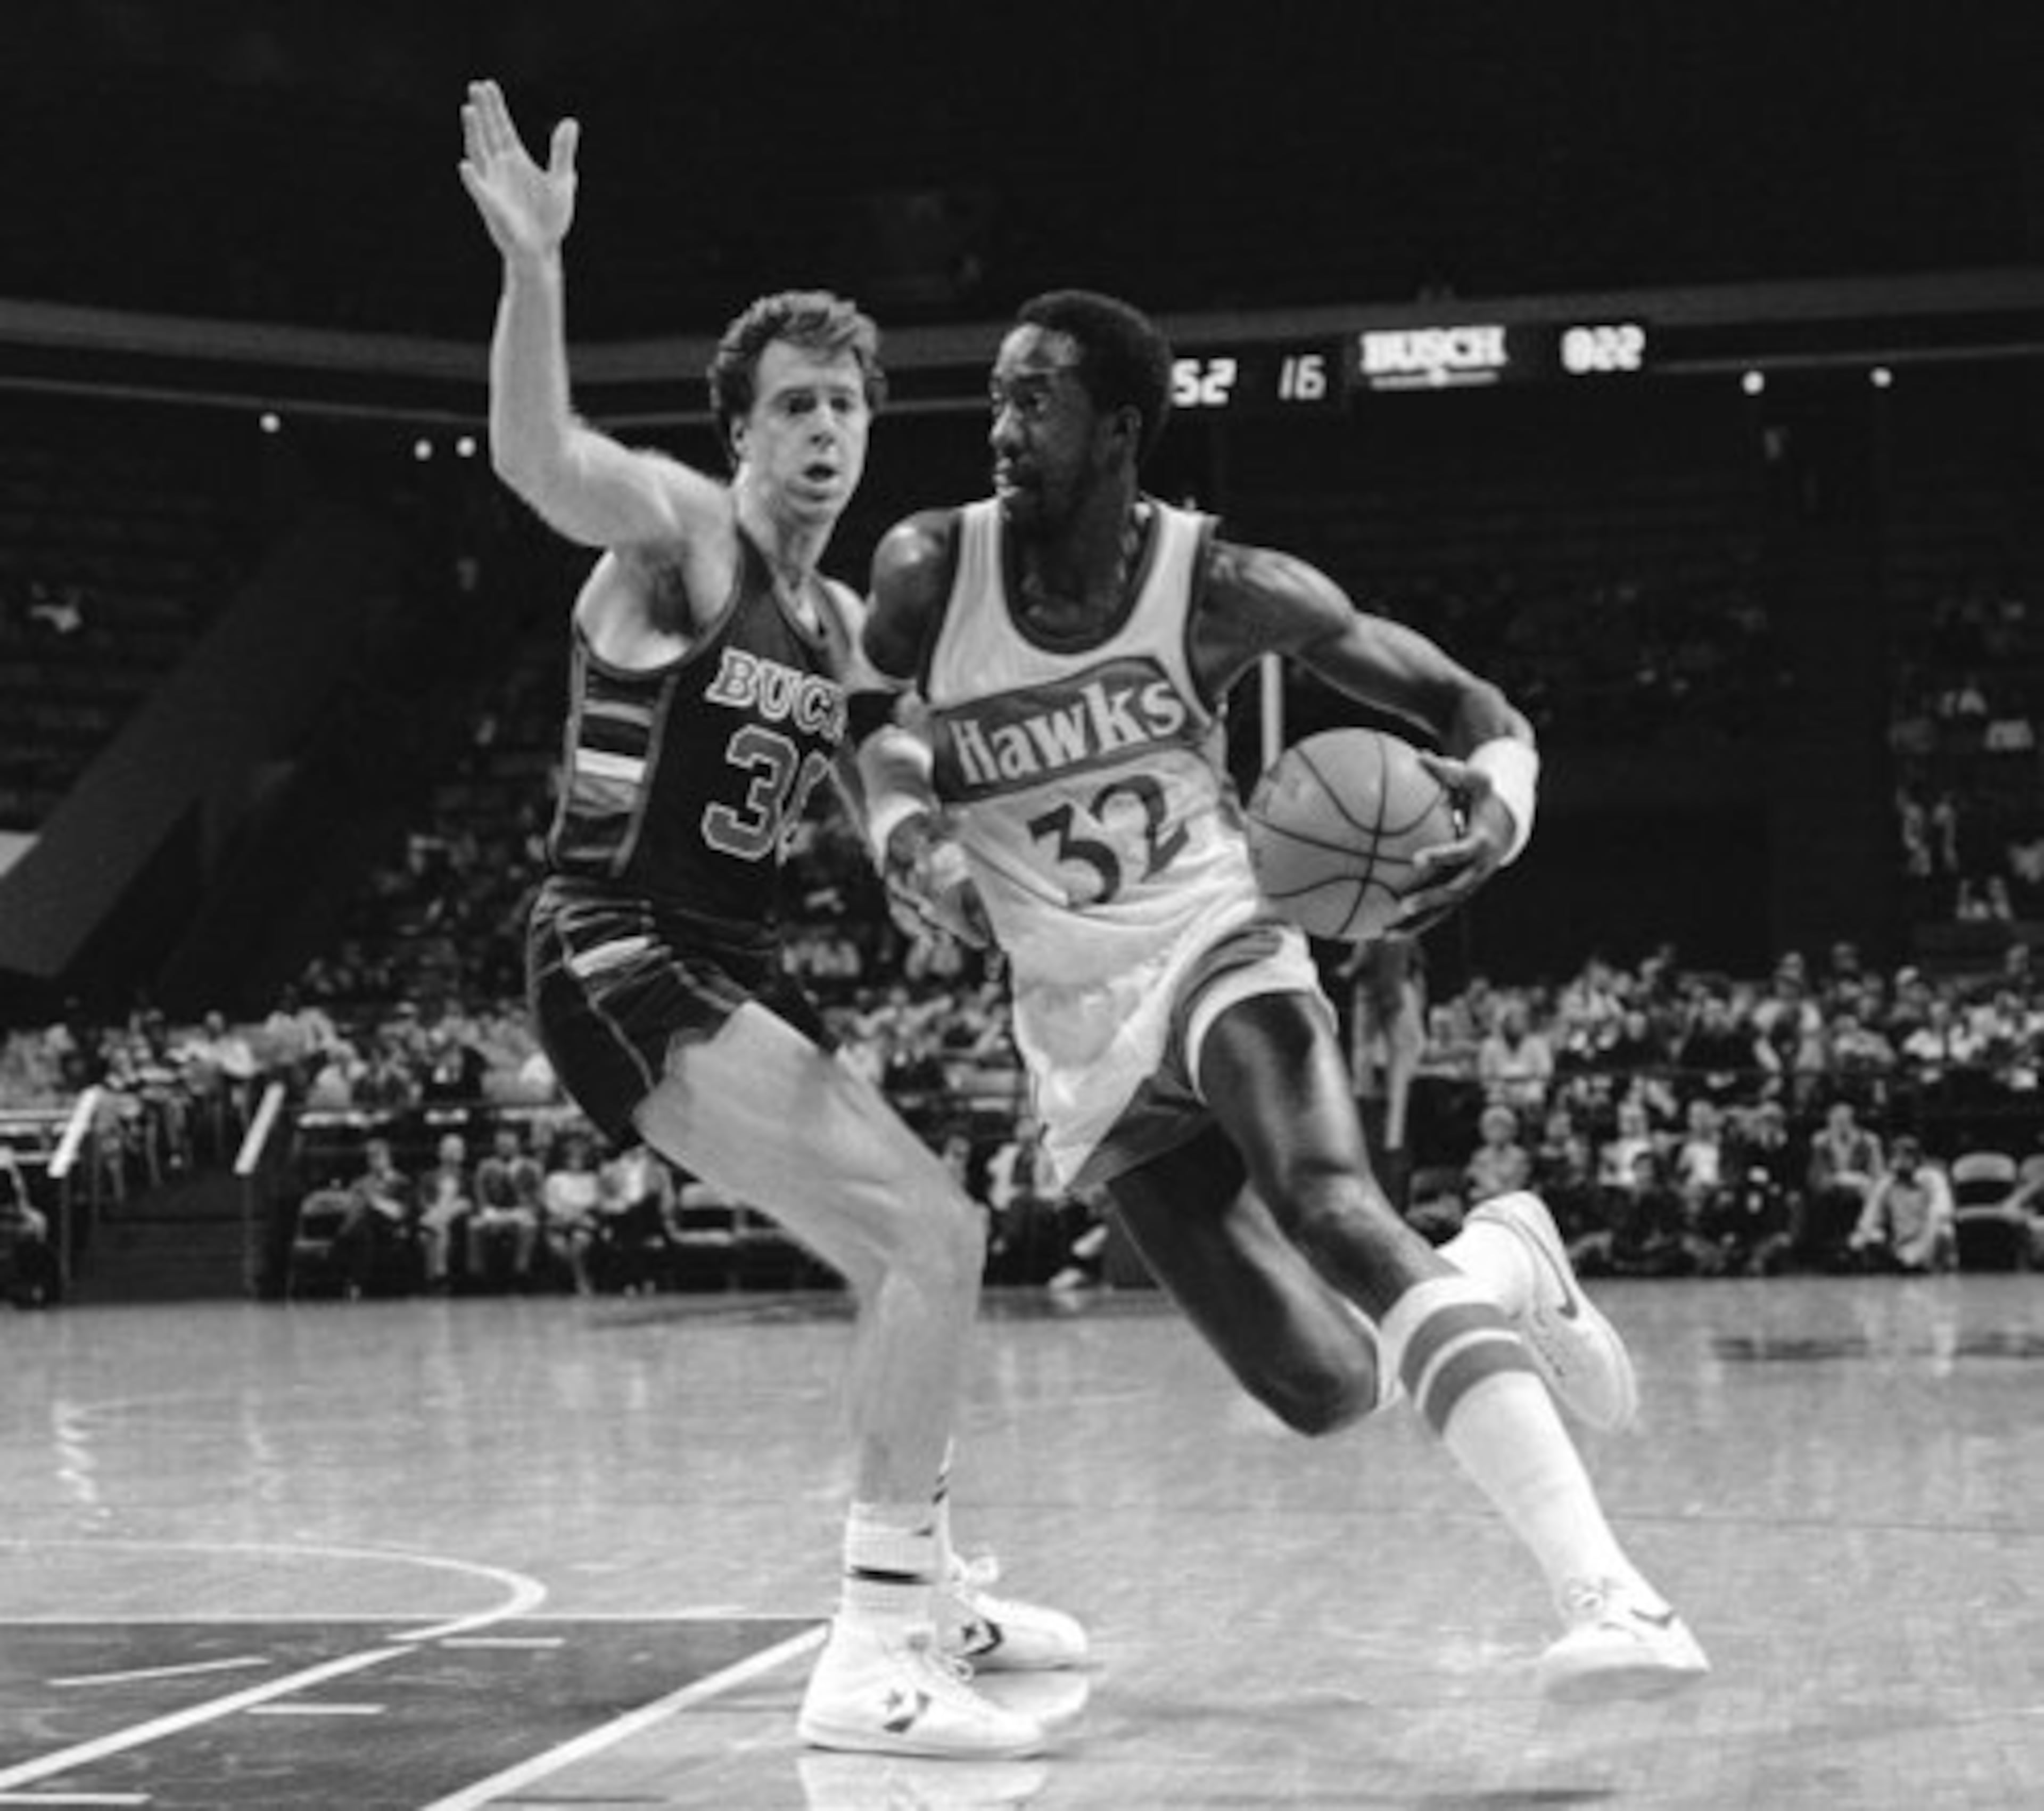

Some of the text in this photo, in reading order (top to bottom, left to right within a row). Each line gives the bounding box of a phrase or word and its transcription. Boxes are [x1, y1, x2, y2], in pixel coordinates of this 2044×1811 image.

[1280, 355, 1325, 399] 16
[1360, 325, 1507, 374] BUSCH
[949, 681, 1186, 785] Hawks
[1027, 775, 1190, 903] 32
